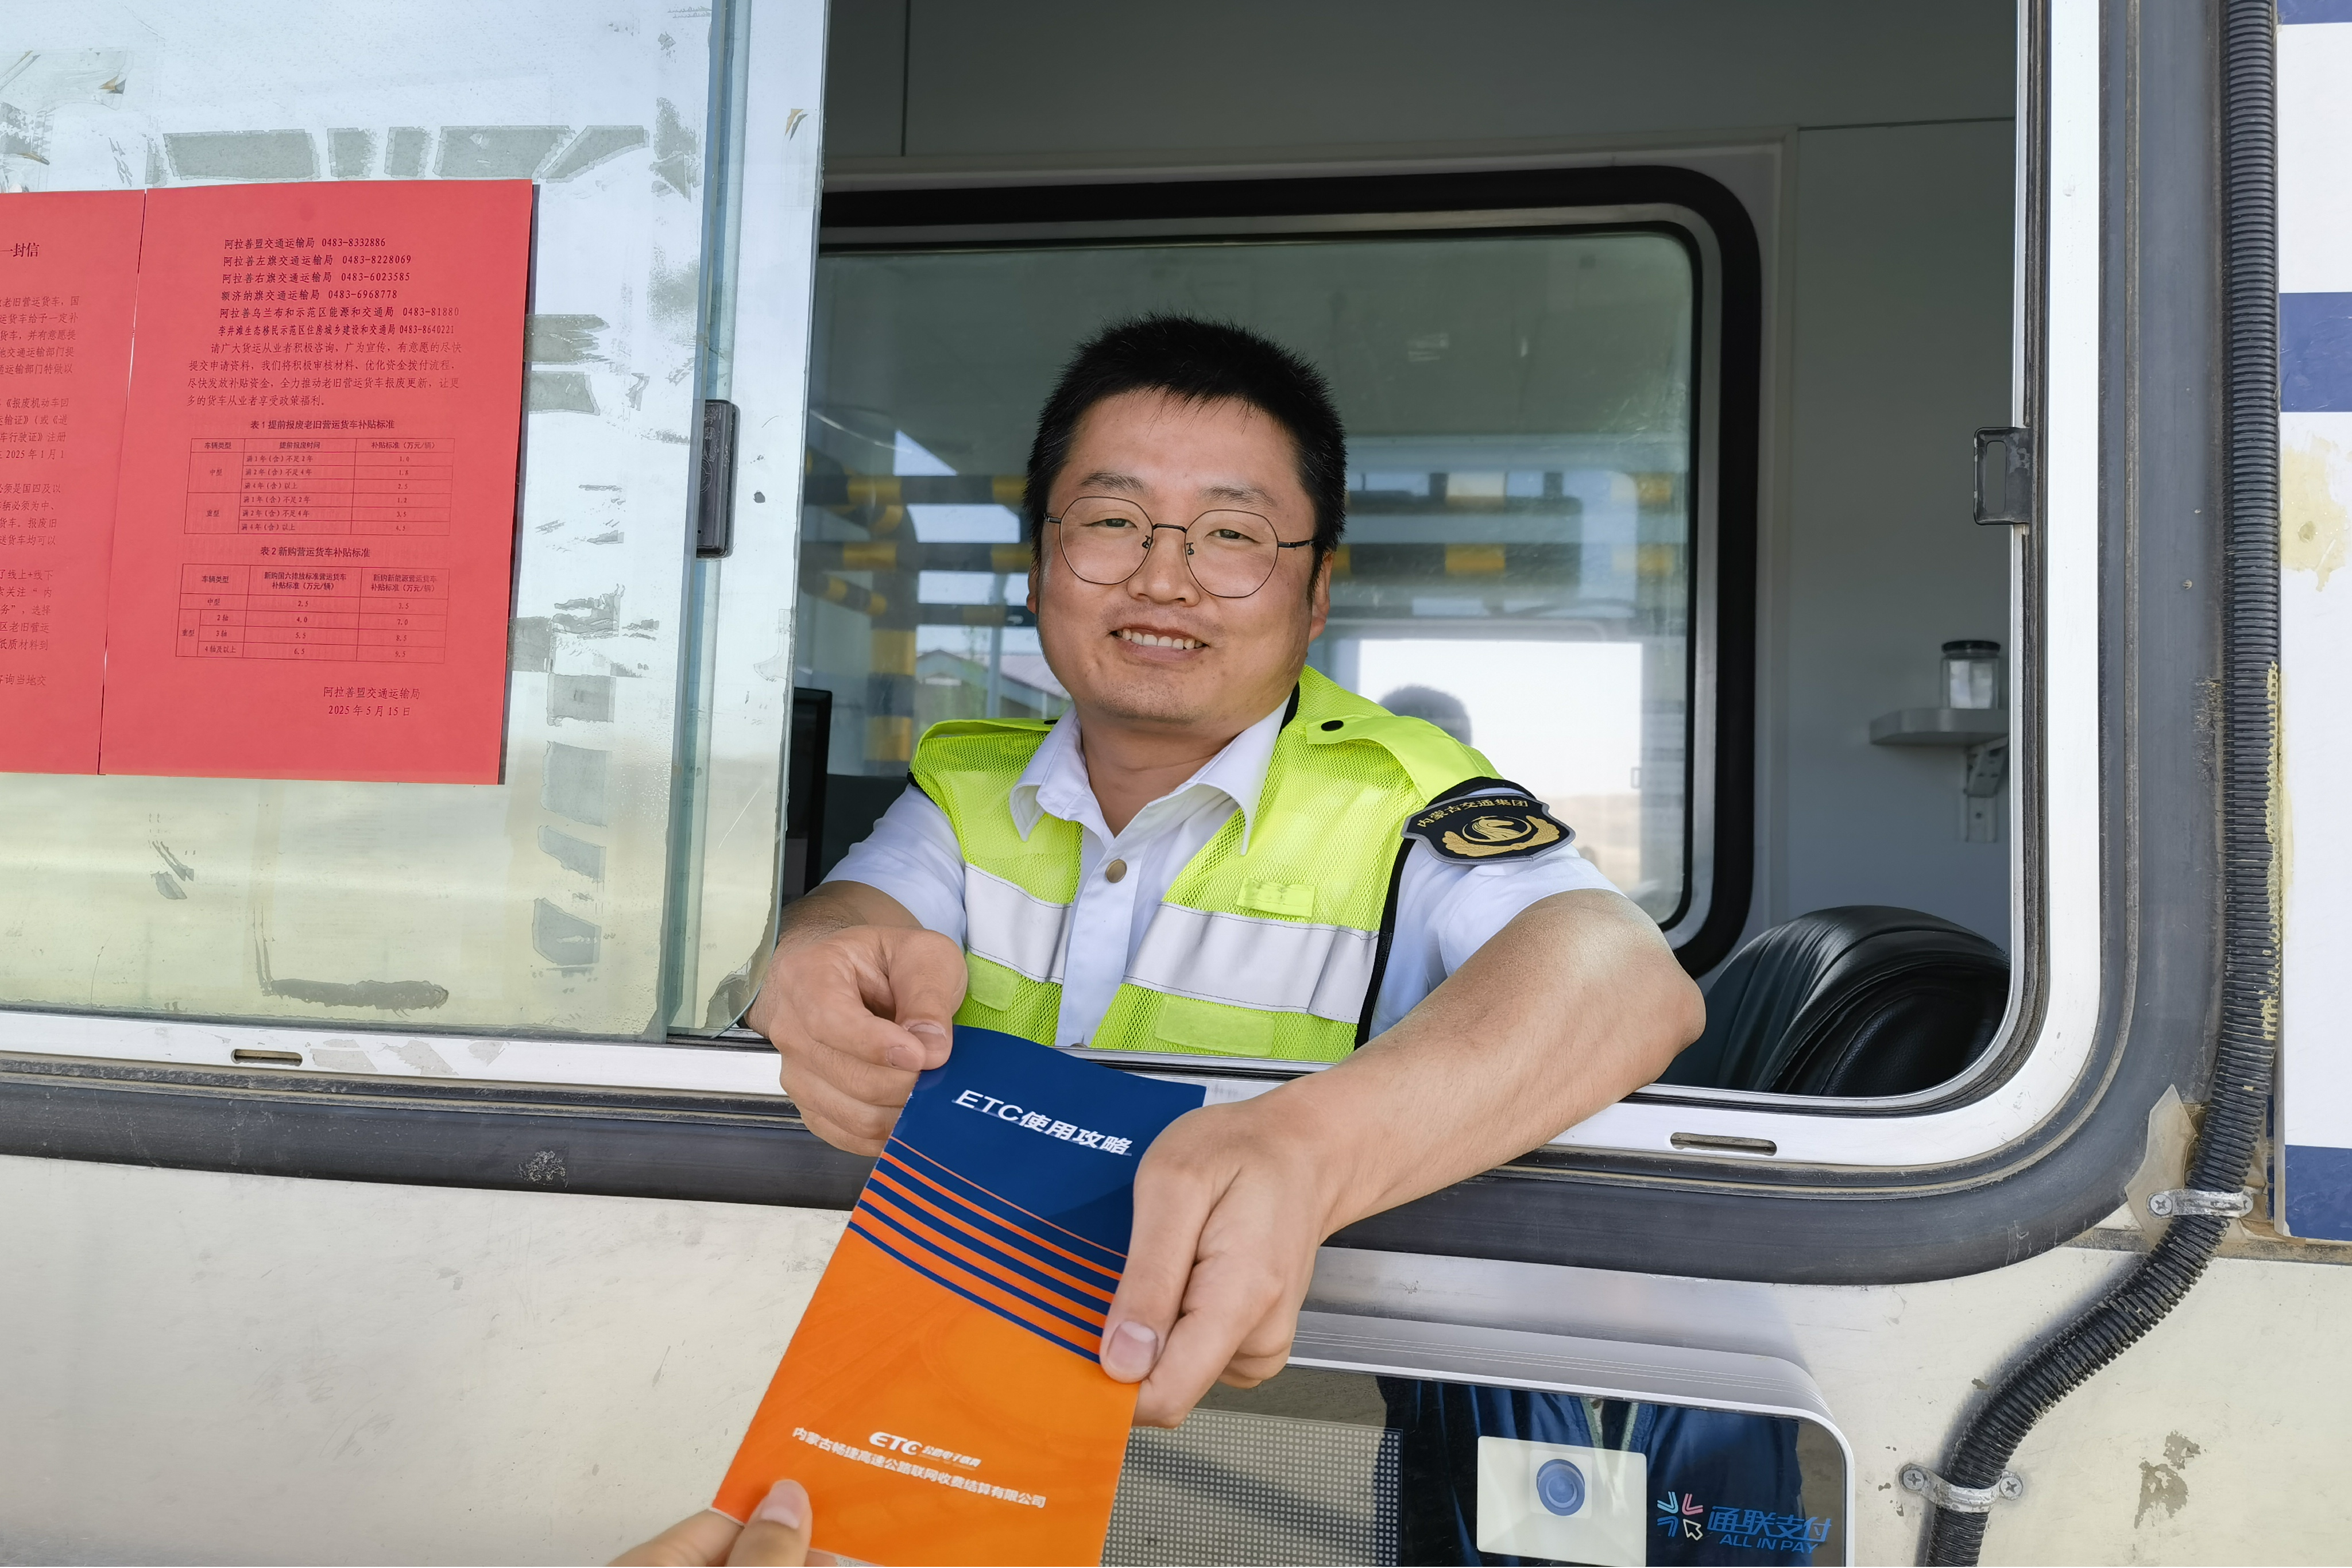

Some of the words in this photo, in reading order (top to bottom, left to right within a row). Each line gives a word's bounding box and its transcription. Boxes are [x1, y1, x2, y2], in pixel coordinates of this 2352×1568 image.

[224, 237, 315, 250] 阿拉善盟交通运输局
[322, 237, 386, 247] 0483-8332886
[223, 254, 333, 267] 阿拉善左旗交通运输局
[342, 254, 412, 264] 0483-8228069
[222, 271, 332, 284] 阿拉善右旗交通运输局
[341, 272, 410, 281] 0483-6023585
[0, 295, 80, 308] 老旧营运货车，国
[220, 289, 320, 302] 额济纳旗交通运输局
[328, 289, 397, 299] 0483-6968778
[219, 305, 394, 319] 阿拉善乌兰布和示范区能源和交通局
[399, 324, 454, 334] 0483-8640221
[0, 397, 69, 409] 《报废机动车回
[0, 448, 64, 460] 2025年1月1
[0, 500, 54, 512] 辆必须为中、
[323, 686, 420, 700] 阿拉善盟交通运输局
[1417, 799, 1528, 828] 内蒙古交通集团
[955, 1089, 1133, 1155] ETC使用攻略
[869, 1431, 923, 1455] ETC
[1707, 1505, 1831, 1542] 通联支付
[1719, 1534, 1753, 1547] ALL
[1757, 1538, 1777, 1550] IN
[1781, 1540, 1819, 1554] PAY
